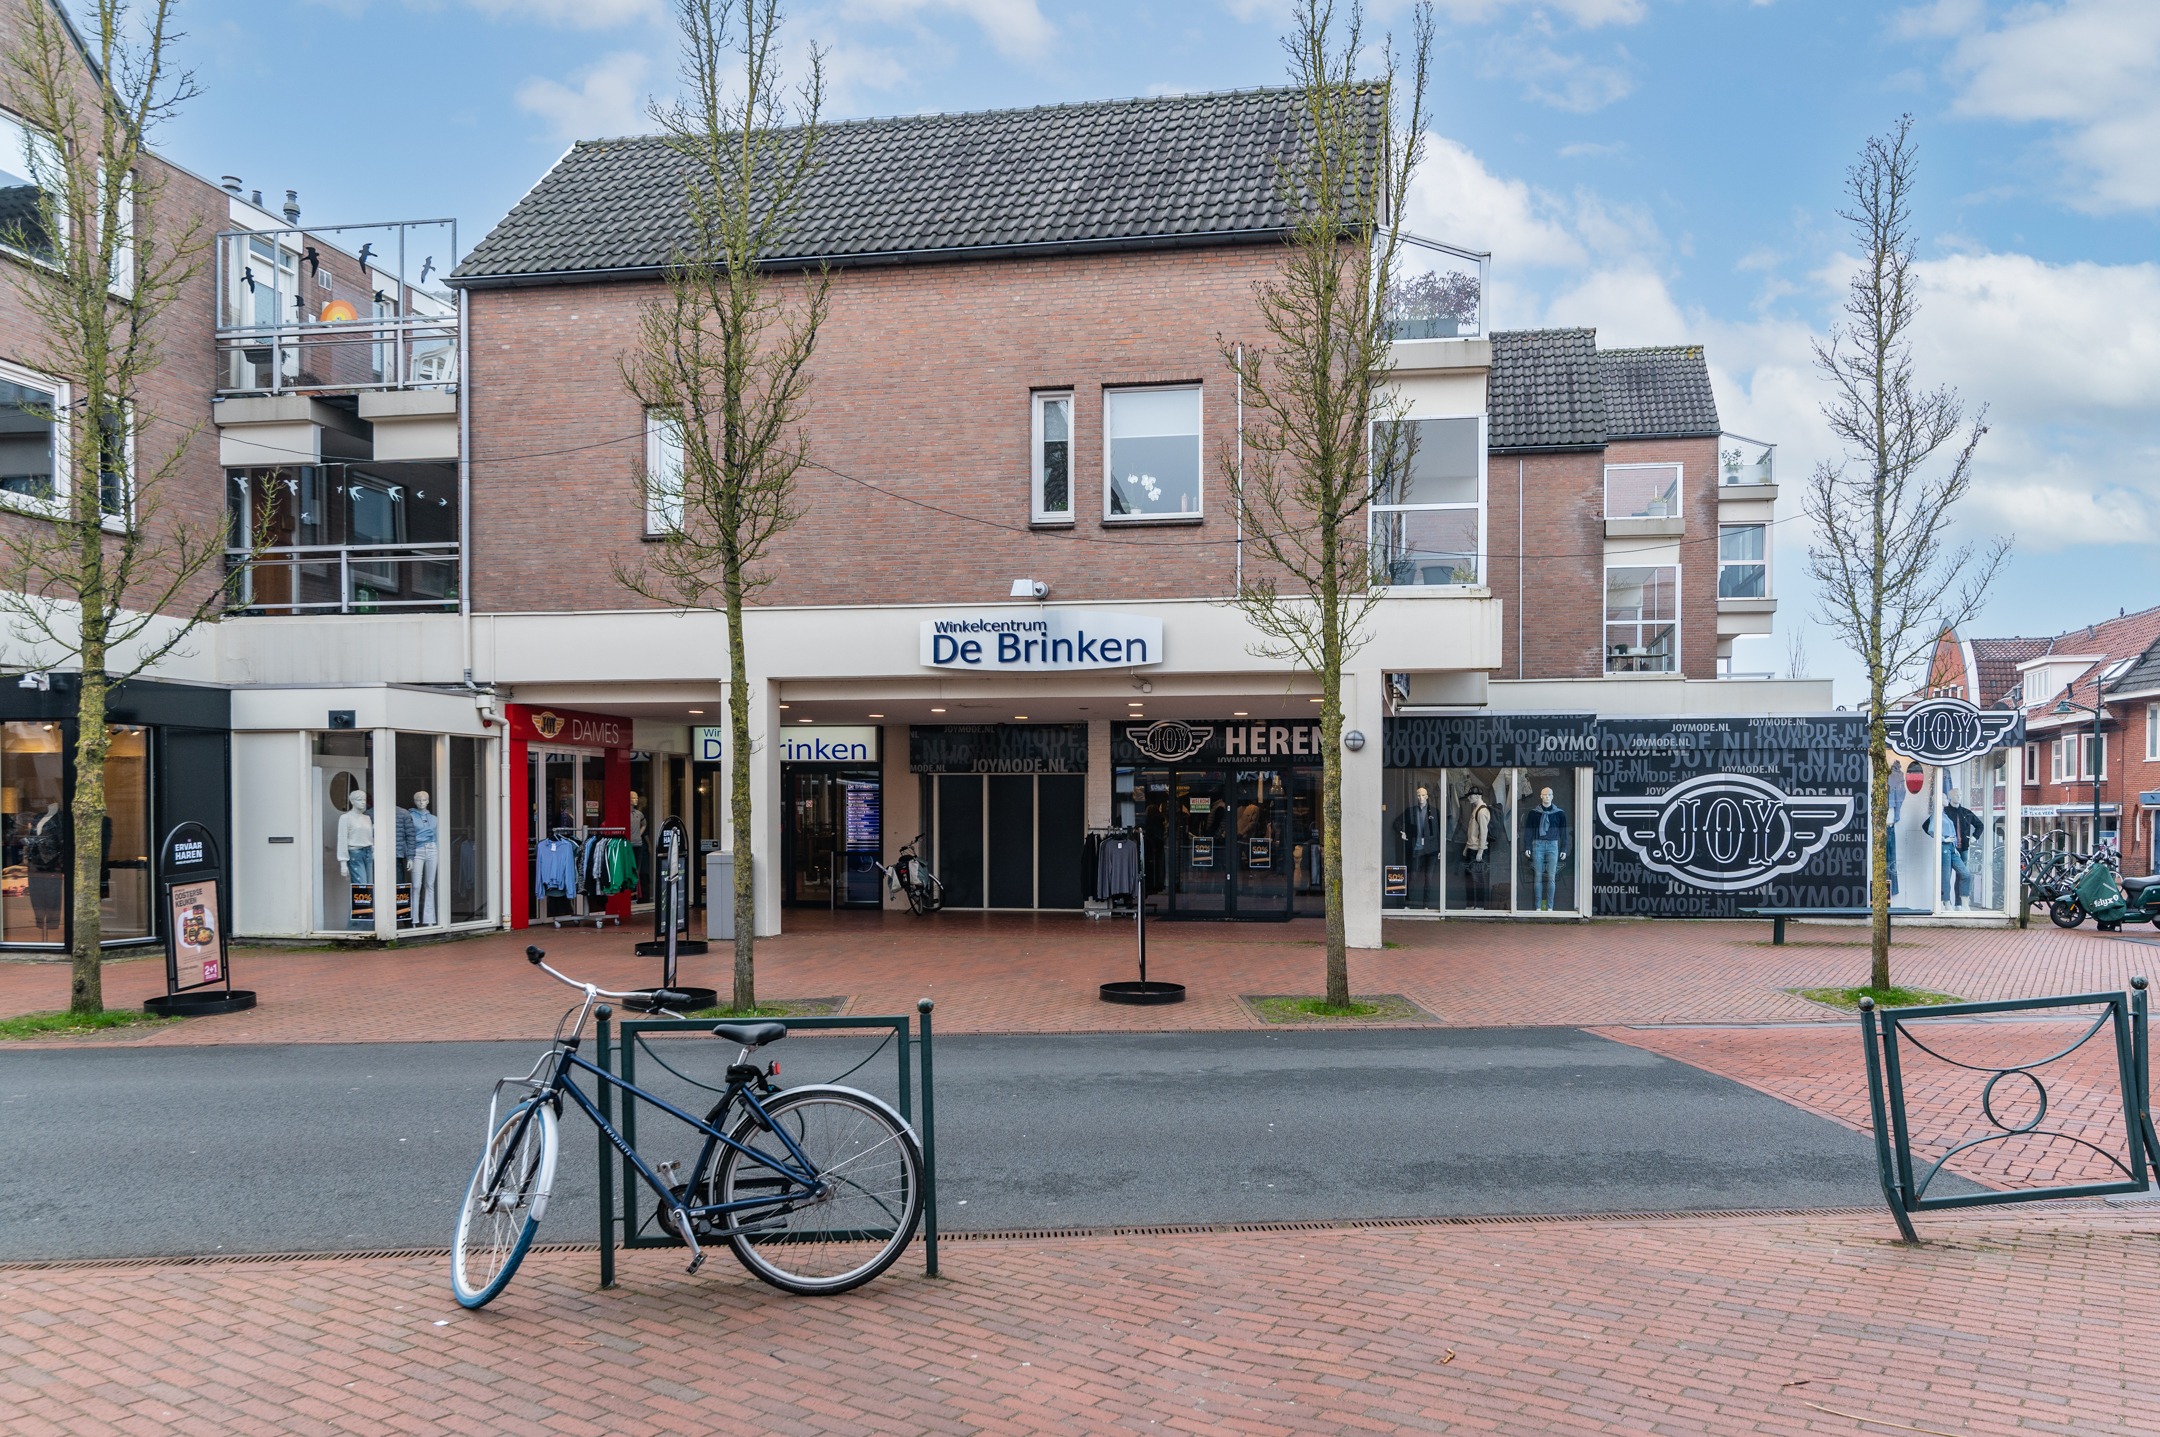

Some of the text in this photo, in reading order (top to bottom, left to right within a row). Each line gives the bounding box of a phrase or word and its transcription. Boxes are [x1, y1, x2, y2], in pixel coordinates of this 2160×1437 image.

[934, 619, 1047, 633] Winkelcentrum
[933, 630, 1148, 664] De Brinken
[541, 716, 557, 734] JOY
[1671, 723, 1731, 732] JOYMODE.NL
[1748, 718, 1809, 727] JOYMODE.NL
[572, 719, 620, 744] DAMES
[1906, 712, 1978, 751] JOY
[1147, 727, 1191, 753] JOY
[1225, 726, 1324, 755] HEREN
[1538, 736, 1597, 751] JOYMO
[1632, 738, 1691, 747] JOYMODE.NL
[780, 738, 868, 760] inken
[1383, 744, 1549, 768] JOYMODE.NL
[910, 764, 947, 773] MODE.NL
[970, 758, 1069, 773] JOYMODE.NL
[1662, 797, 1784, 866] JOY
[174, 841, 203, 851] ERVAAR
[175, 850, 203, 860] HAREN
[174, 888, 203, 900] OOSTERSE
[1593, 885, 1640, 894] YMODE.NL
[175, 897, 198, 908] KEUKEN
[353, 893, 373, 901] 50%
[2093, 897, 2113, 908] felyx
[204, 963, 217, 976] 2+1
[603, 1125, 631, 1156] SWAPFIETS
